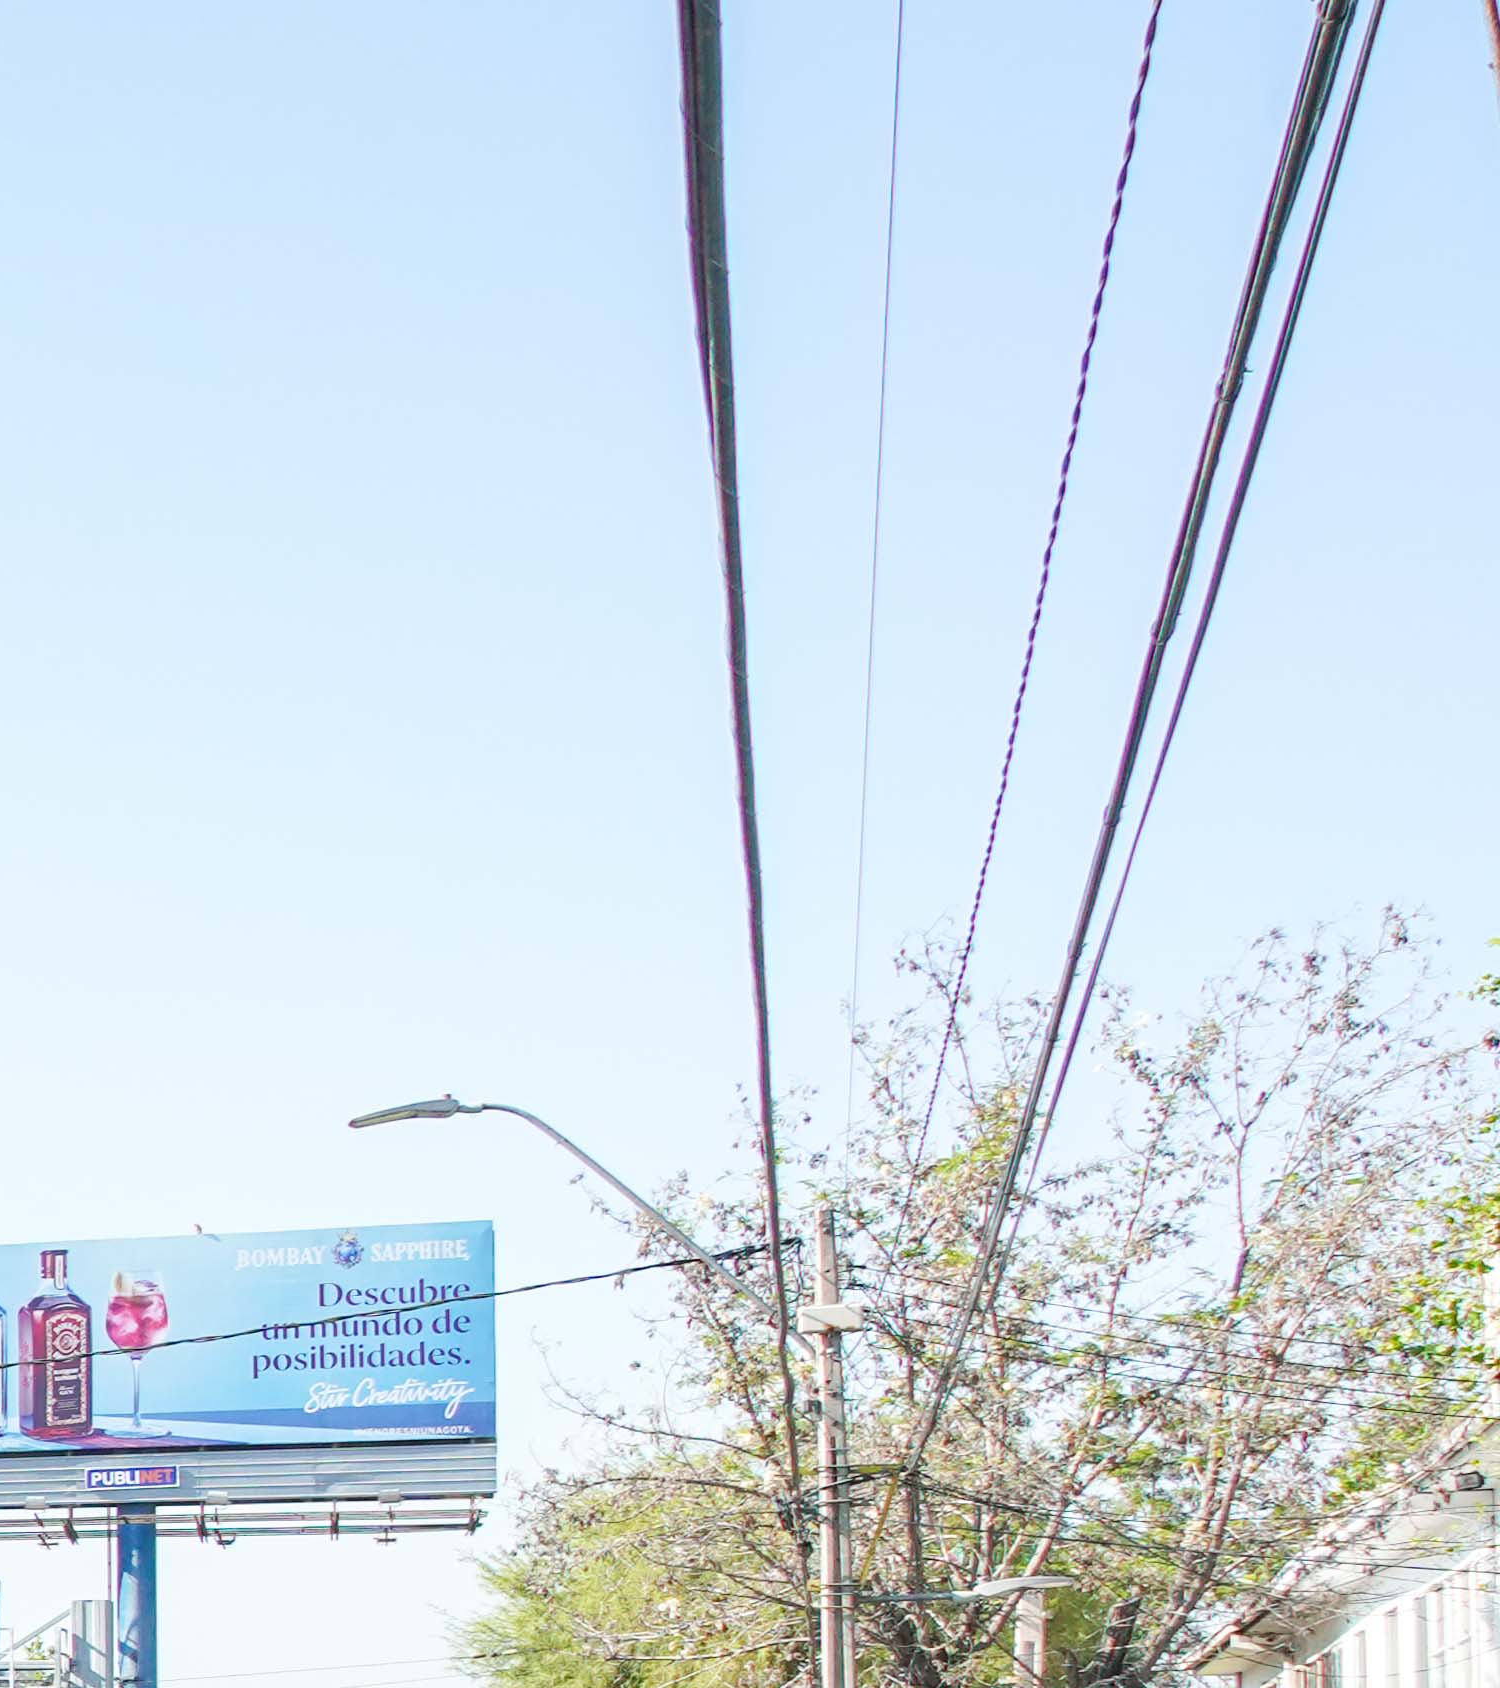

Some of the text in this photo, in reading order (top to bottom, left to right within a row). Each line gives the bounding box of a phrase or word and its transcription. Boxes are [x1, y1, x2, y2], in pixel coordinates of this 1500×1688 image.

[235, 1239, 471, 1271] BOMBAY SAPPHIRE
[318, 1278, 471, 1307] Descubre
[262, 1308, 471, 1341] un mundo de
[252, 1341, 471, 1379] posibilidades.
[304, 1377, 476, 1419] Stir Creativity
[91, 1468, 174, 1487] PUBLINET
